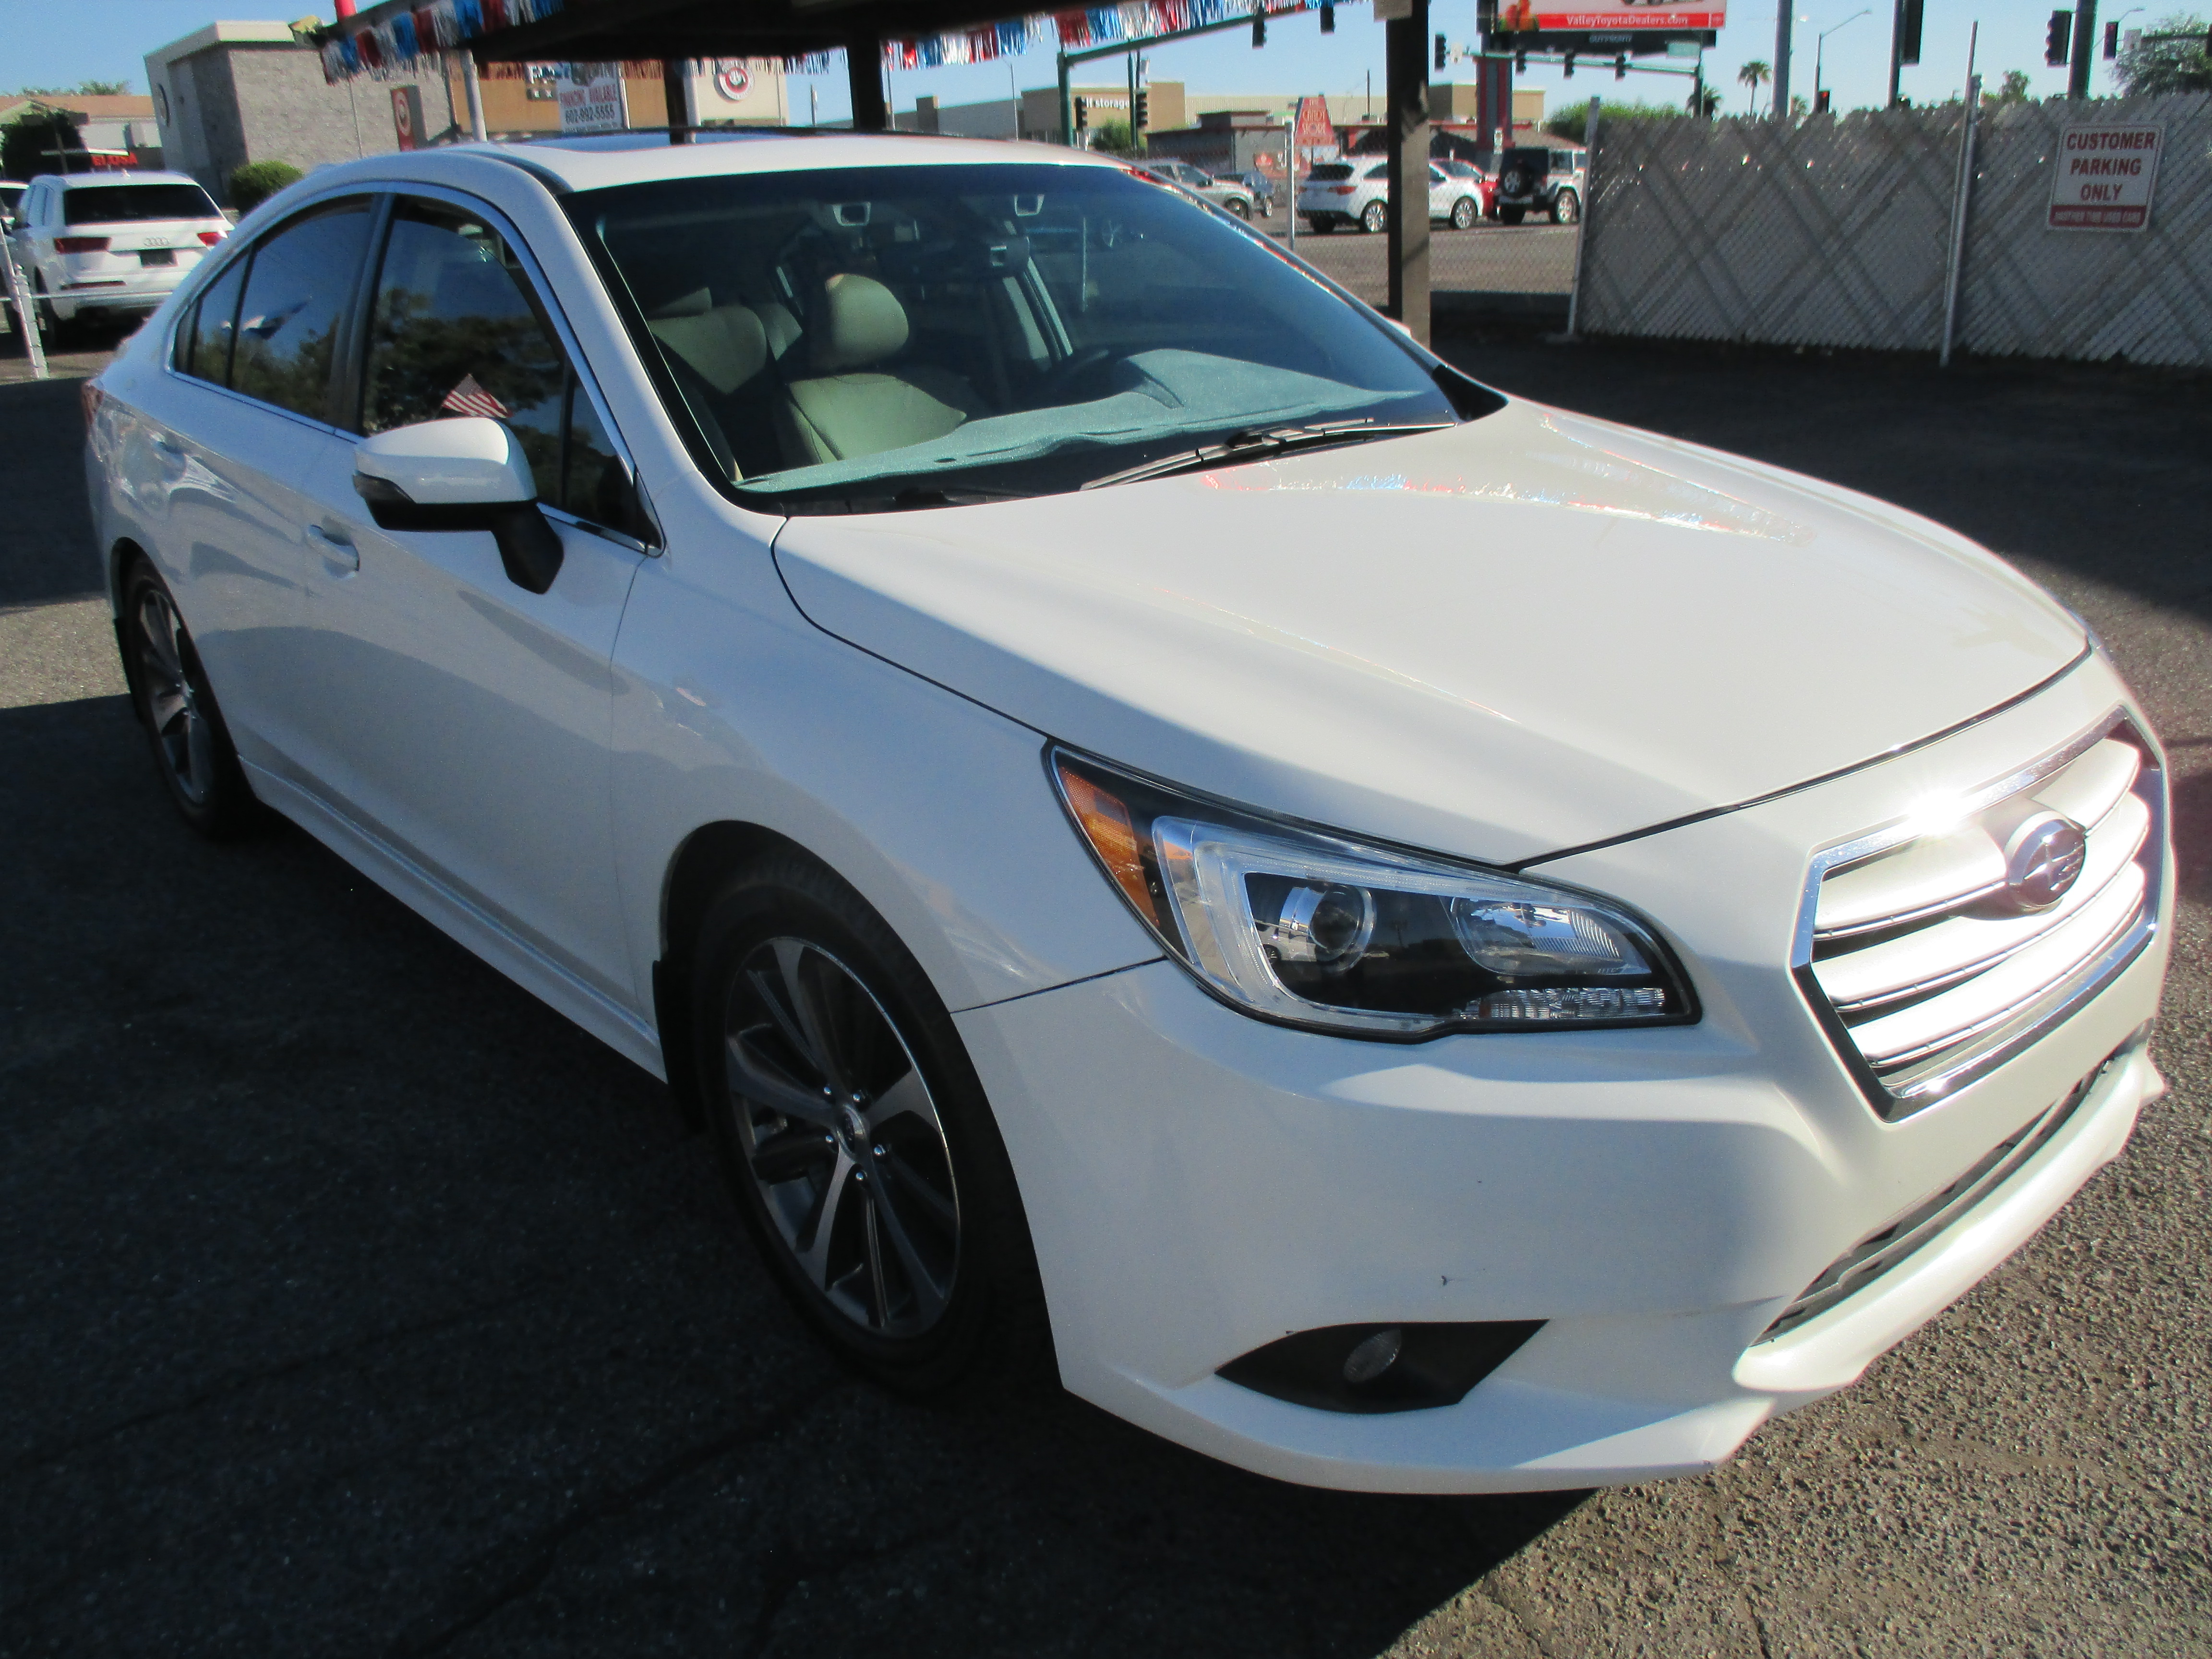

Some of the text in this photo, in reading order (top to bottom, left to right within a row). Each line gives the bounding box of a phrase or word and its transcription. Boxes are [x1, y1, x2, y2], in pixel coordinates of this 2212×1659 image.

[1566, 14, 1688, 28] ValleyToyotaDealers.com
[2067, 131, 2156, 151] CUSTOMER
[2069, 158, 2142, 176] PARKING
[2080, 183, 2123, 201] ONLY
